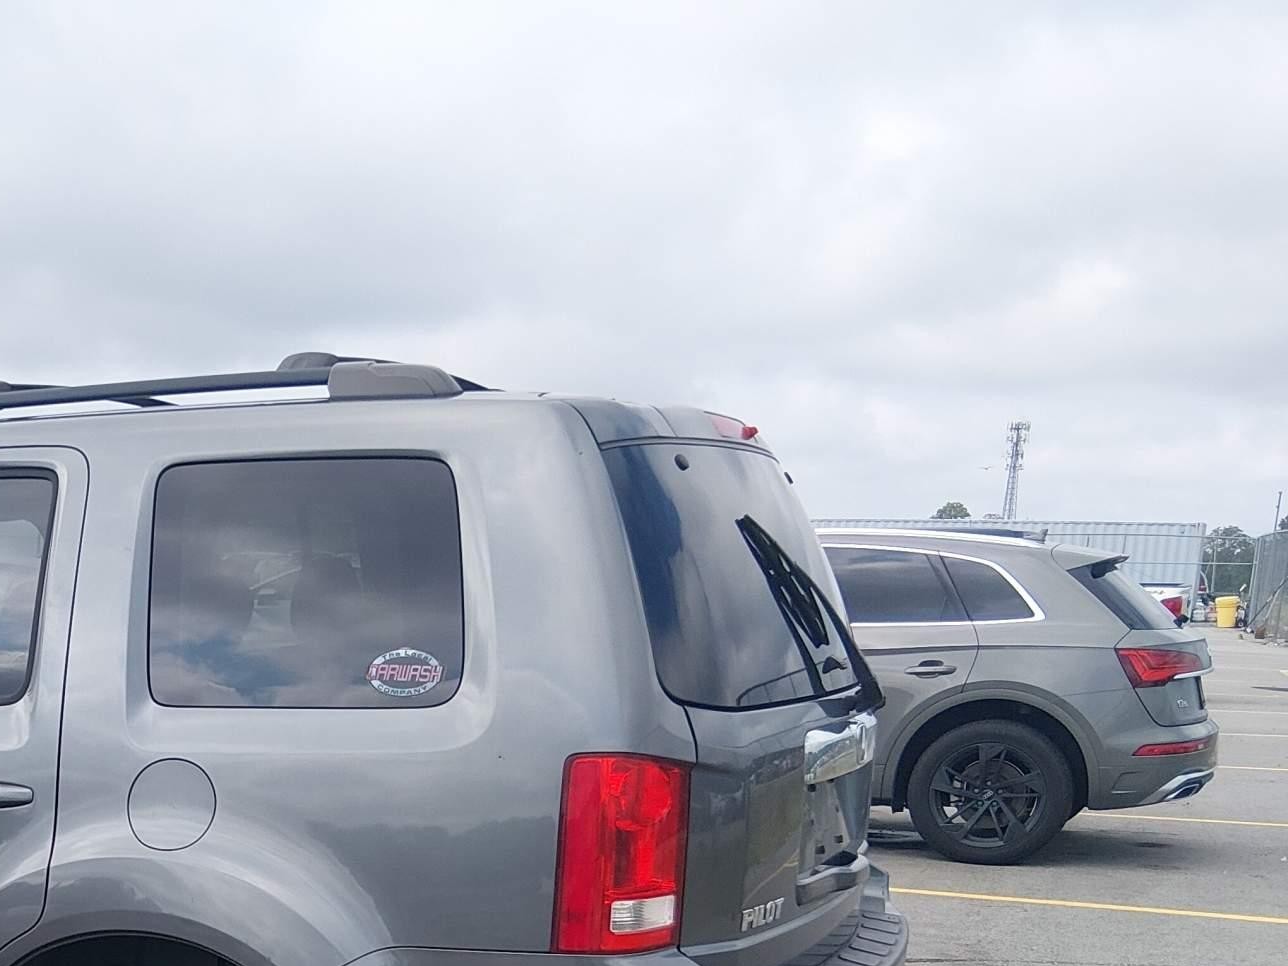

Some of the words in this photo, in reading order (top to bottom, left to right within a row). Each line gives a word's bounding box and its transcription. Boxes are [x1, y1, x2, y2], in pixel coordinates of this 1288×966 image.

[382, 651, 401, 661] The
[404, 650, 433, 663] Local
[377, 683, 428, 695] COMPANY
[740, 896, 785, 932] PILOT
